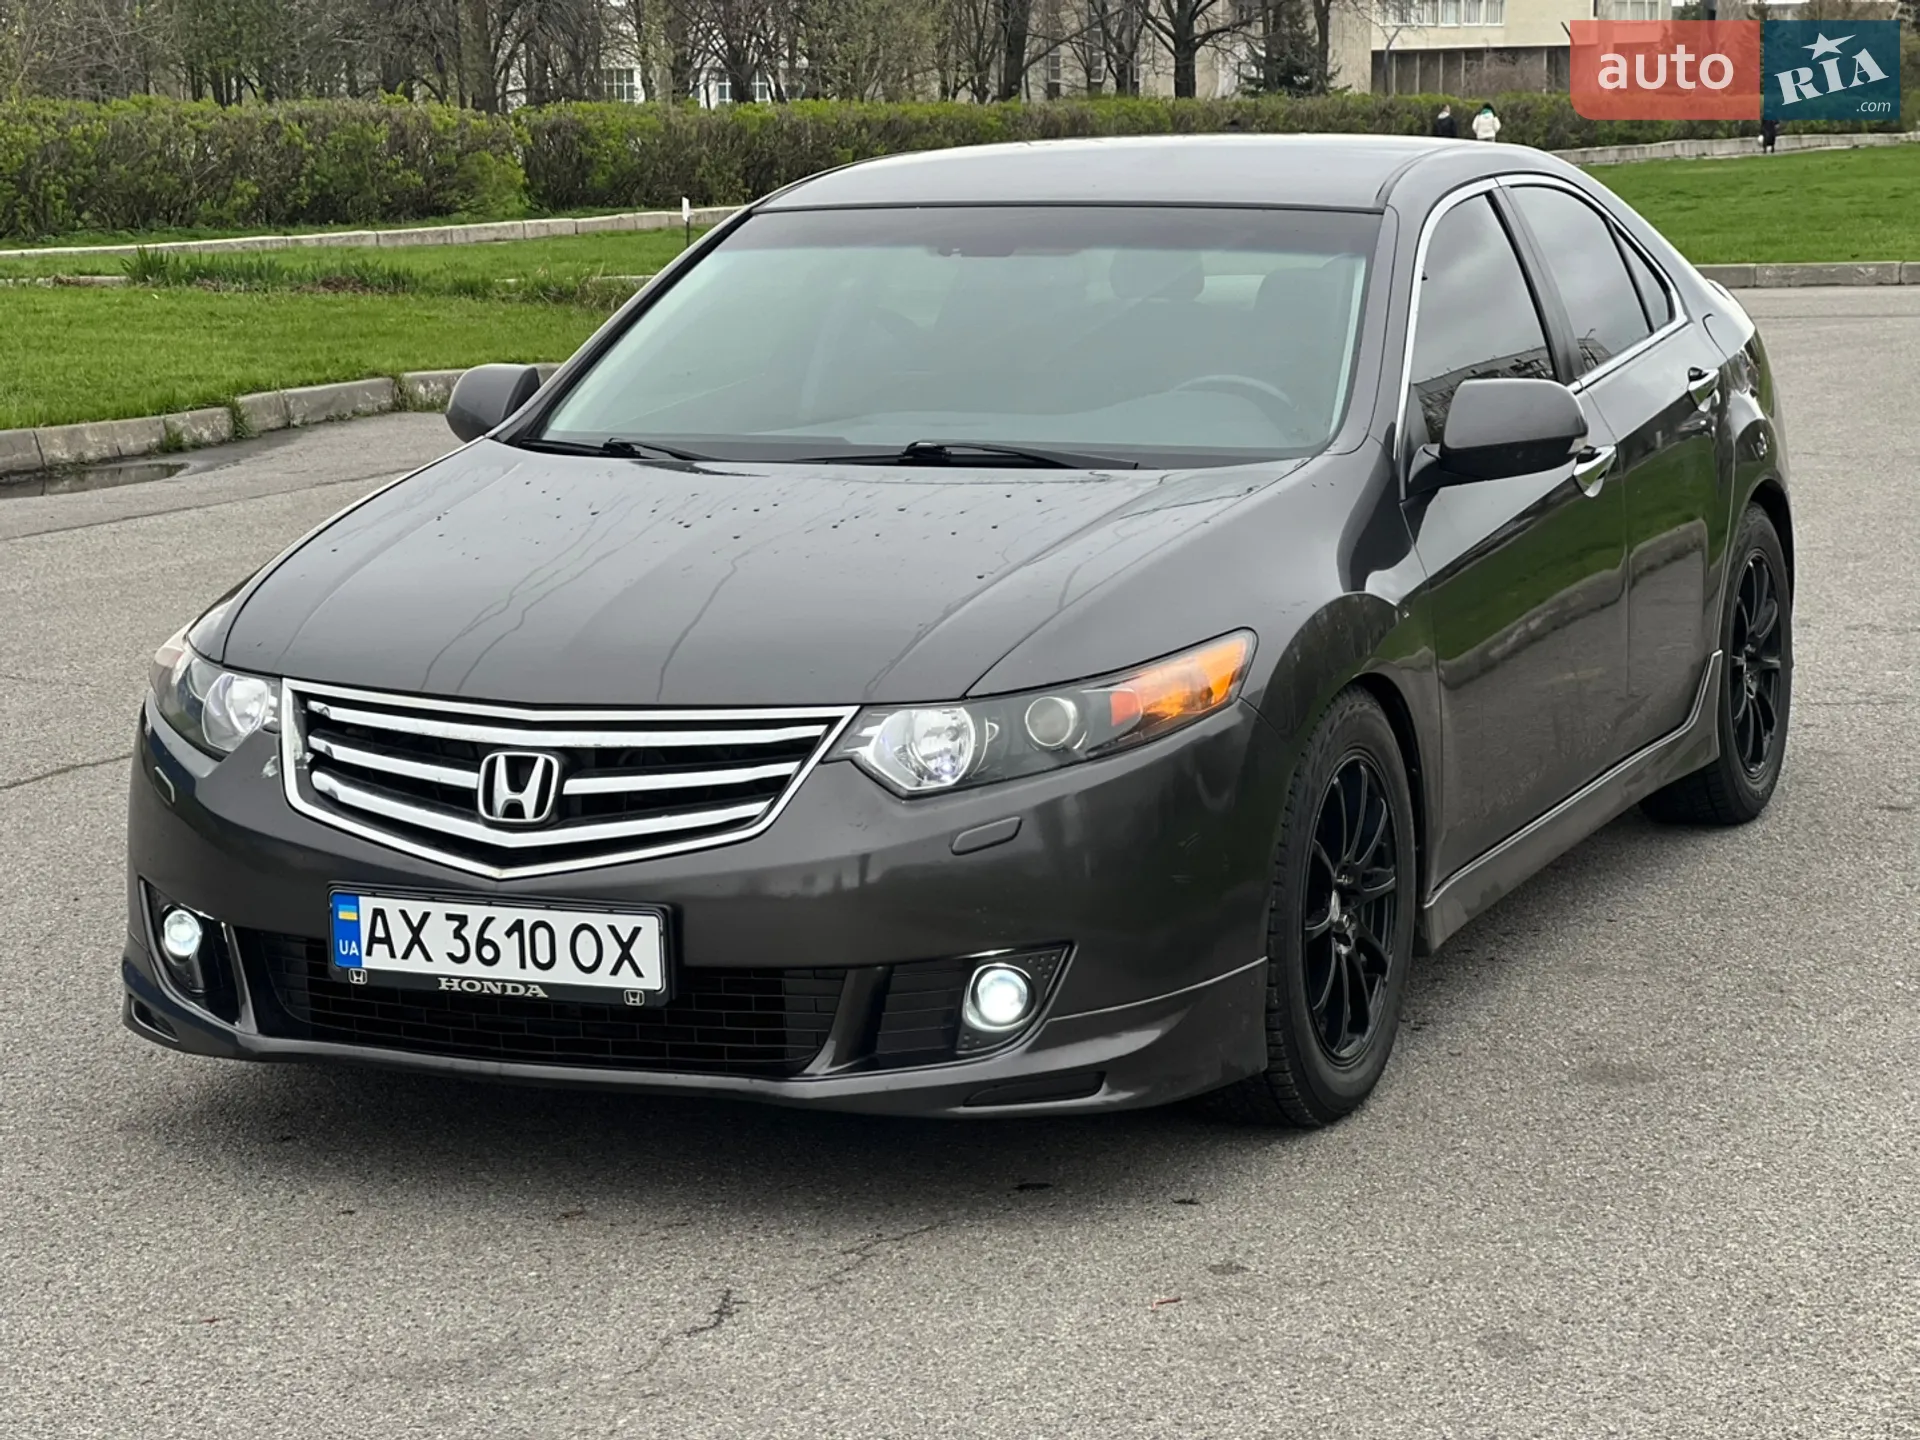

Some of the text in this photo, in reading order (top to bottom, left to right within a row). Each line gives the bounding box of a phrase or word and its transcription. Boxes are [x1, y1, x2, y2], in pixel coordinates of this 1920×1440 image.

[339, 938, 359, 956] UA
[365, 908, 645, 978] AX 3610 OX
[438, 977, 548, 998] HONDA
